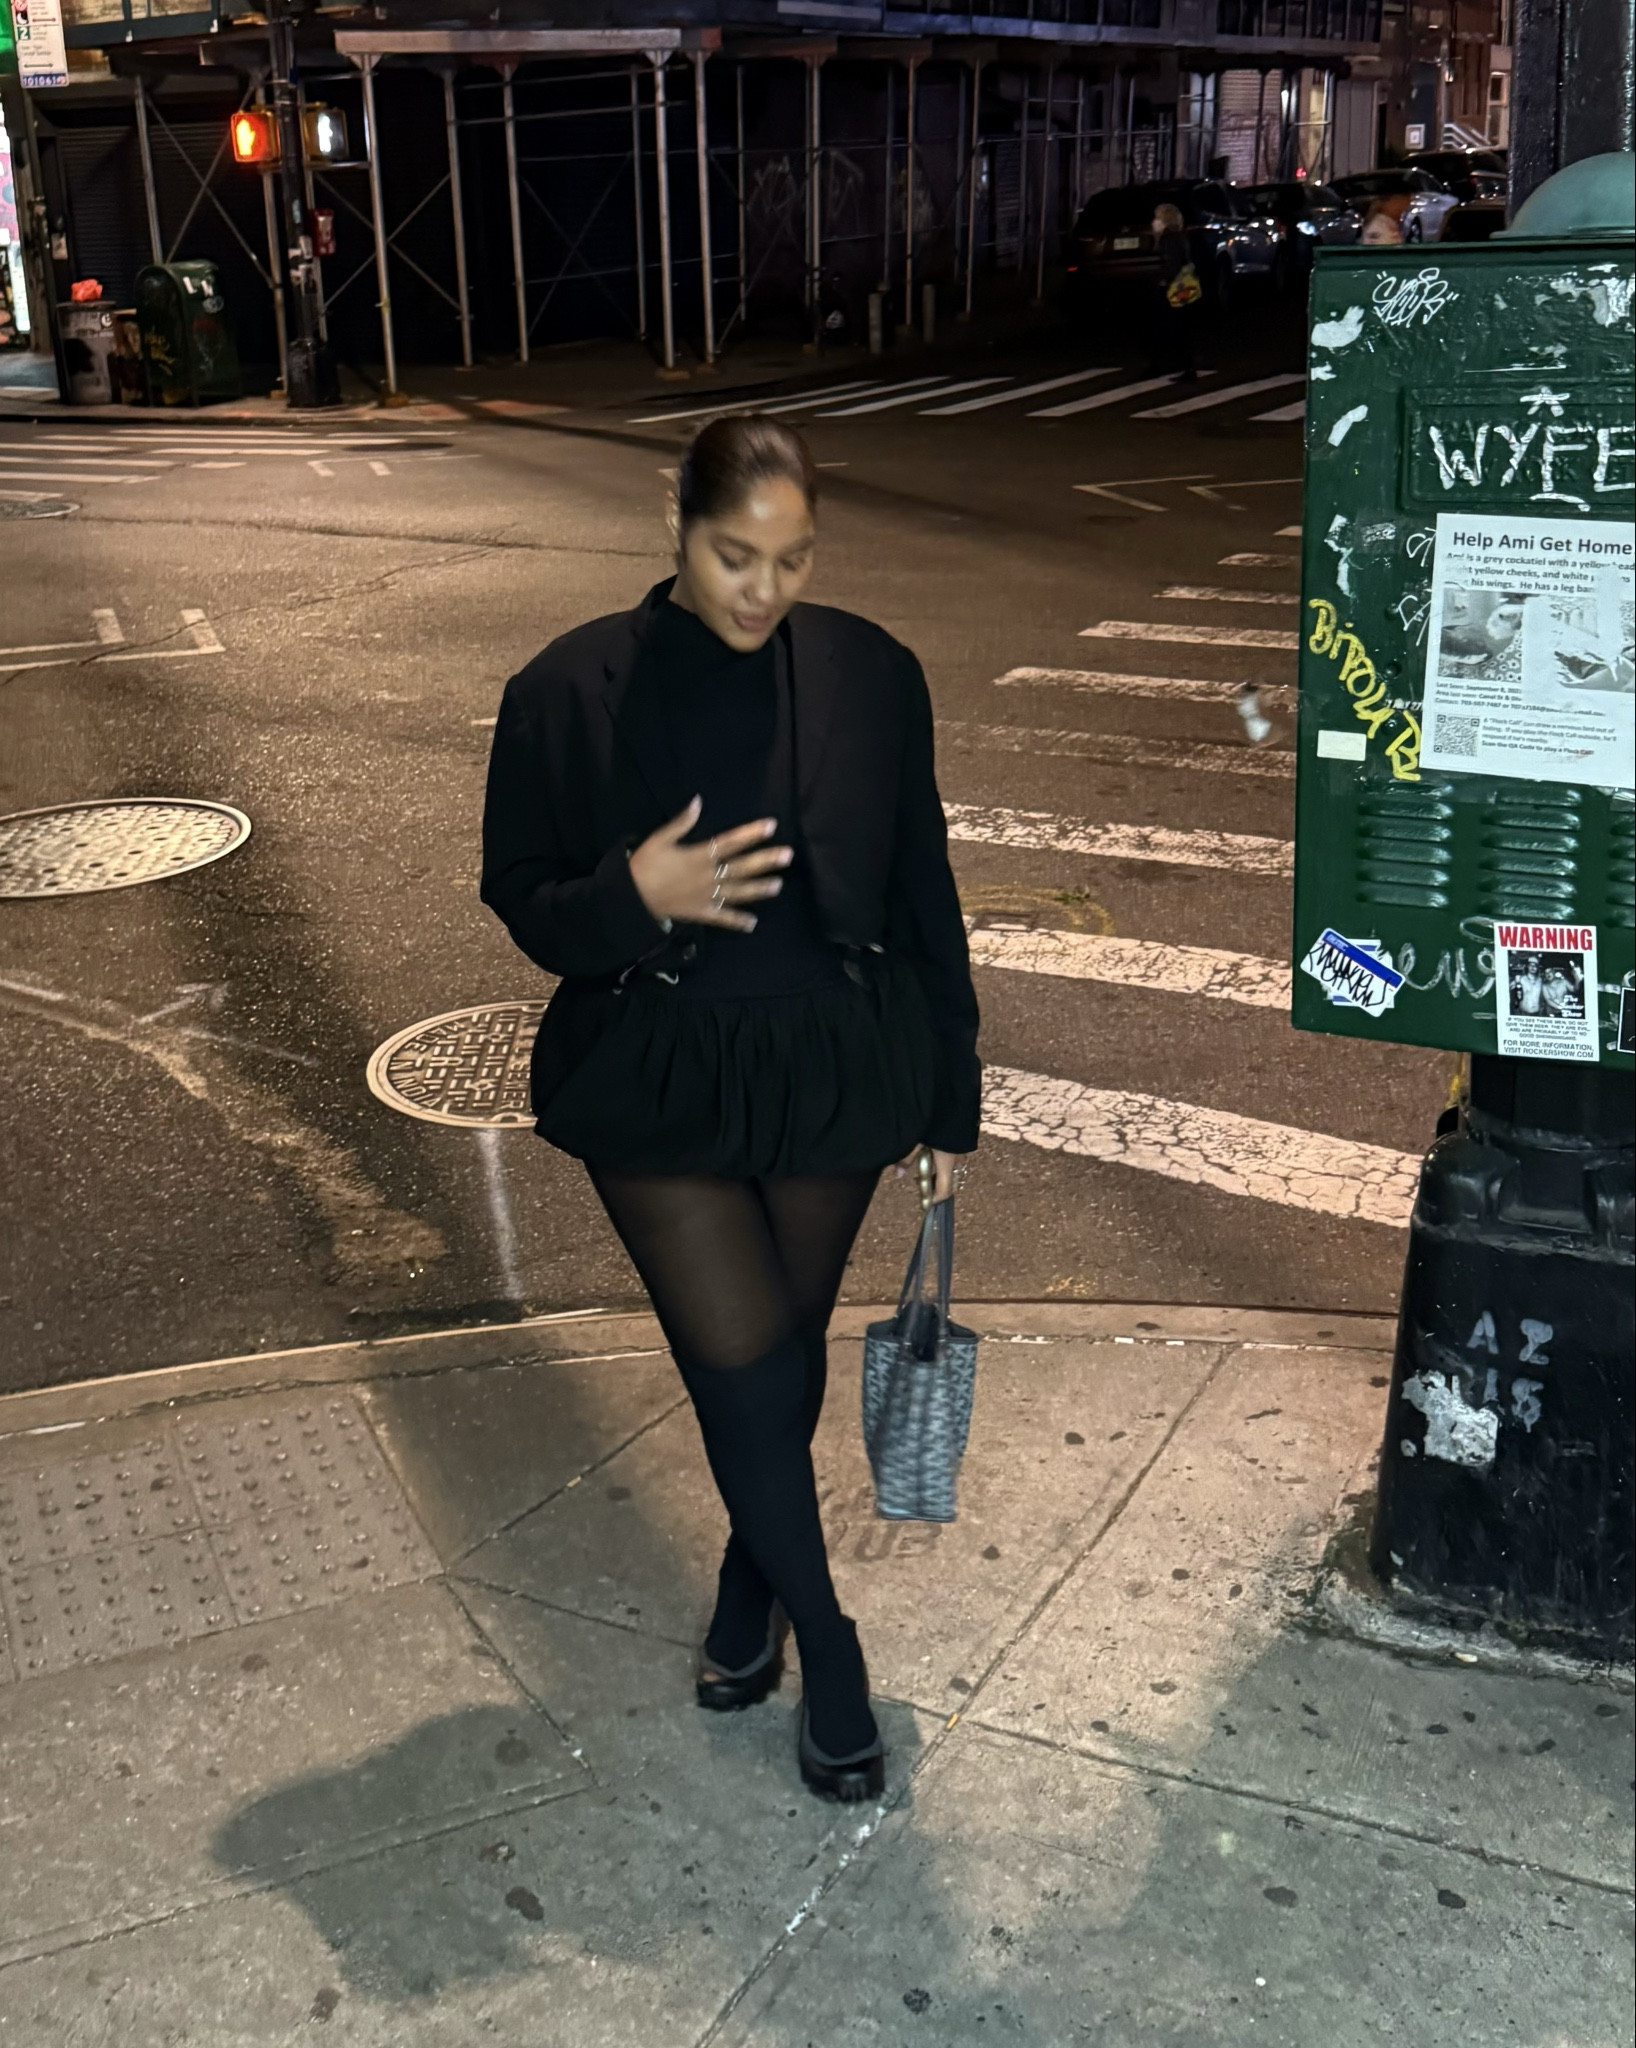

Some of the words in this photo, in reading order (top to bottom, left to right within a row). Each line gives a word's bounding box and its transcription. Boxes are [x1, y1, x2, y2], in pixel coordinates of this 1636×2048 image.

[1453, 532, 1493, 550] Help
[1498, 534, 1535, 550] Ami
[1540, 536, 1573, 552] Get
[1483, 556, 1504, 564] grey
[1505, 556, 1546, 566] cockatiel
[1548, 558, 1569, 567] with
[1474, 566, 1505, 575] yellow
[1506, 568, 1541, 578] cheeks,
[1542, 571, 1560, 579] and
[1562, 572, 1589, 580] white
[1471, 578, 1484, 586] his
[1520, 581, 1533, 589] He
[1534, 582, 1551, 591] has
[1561, 584, 1575, 593] leg
[1498, 925, 1593, 951] WARNING
[404, 1020, 466, 1052] MADE
[1503, 1039, 1518, 1047] FOR
[1519, 1040, 1541, 1049] MORE
[1503, 1046, 1522, 1055] VISIT
[391, 1074, 443, 1108] INDIA
